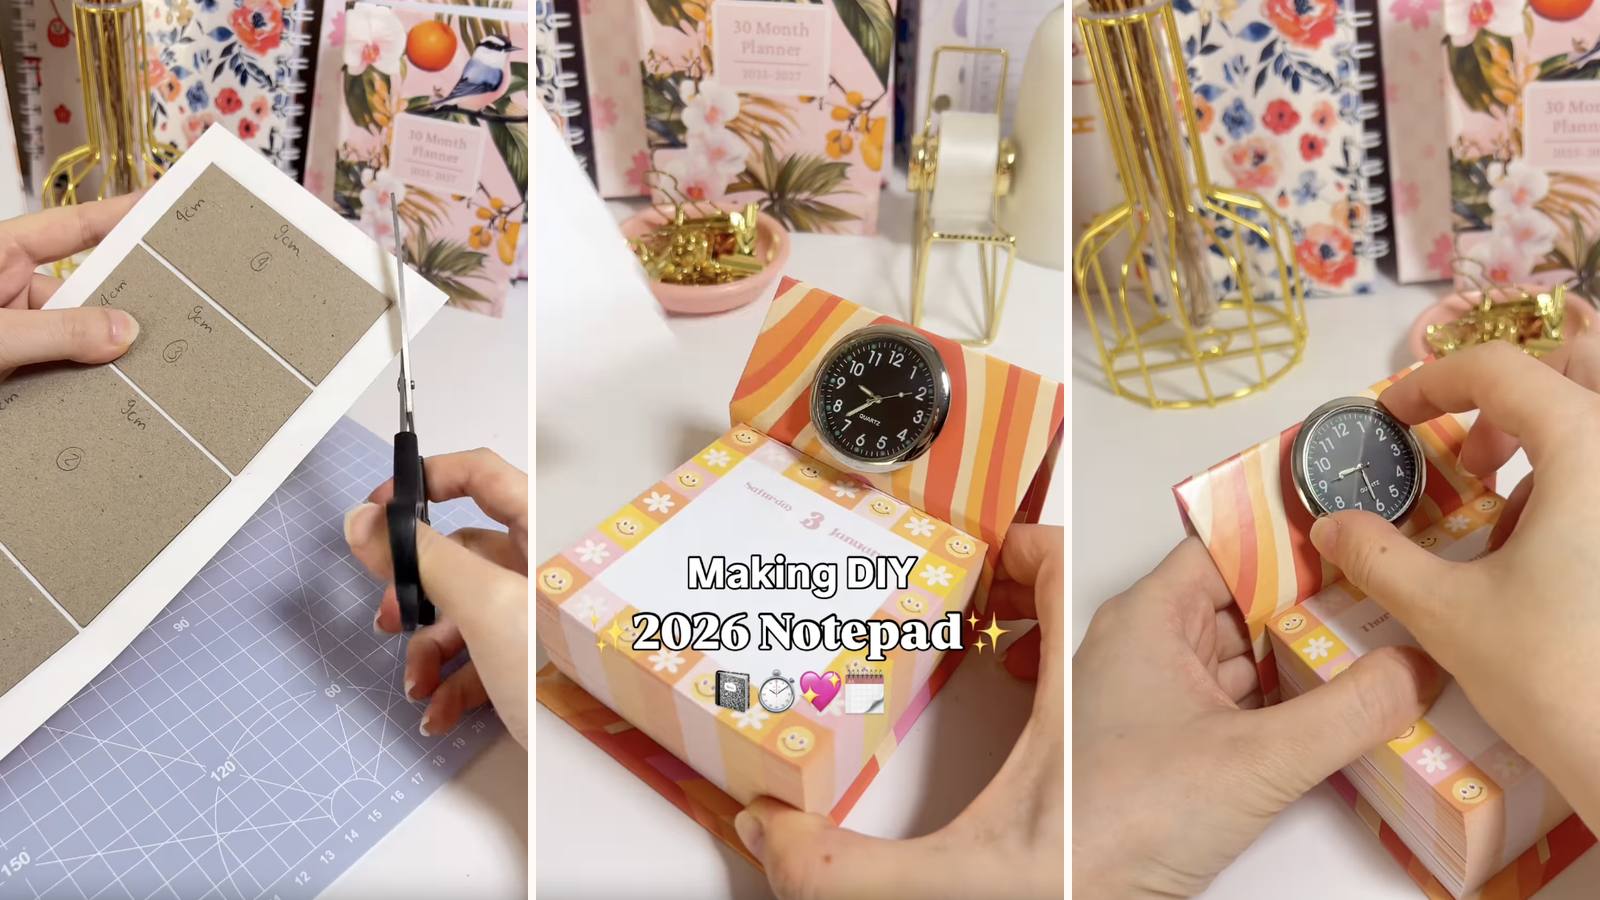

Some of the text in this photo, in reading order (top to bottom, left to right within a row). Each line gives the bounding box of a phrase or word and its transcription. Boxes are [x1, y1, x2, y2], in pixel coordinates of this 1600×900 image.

[733, 20, 809, 37] 30 Month
[741, 39, 802, 56] Planner
[1544, 100, 1565, 114] 30
[425, 131, 467, 150] Month
[412, 144, 459, 163] Planner
[176, 199, 205, 221] 4cm
[274, 224, 300, 257] 9cm
[100, 280, 127, 306] 4cm
[187, 305, 212, 333] 9cm
[868, 350, 882, 367] 11
[888, 350, 905, 368] 12
[849, 360, 865, 376] 10
[910, 366, 918, 380] 1
[836, 376, 846, 390] 9
[915, 386, 927, 401] 2
[833, 400, 843, 413] 8
[121, 399, 146, 430] 9cm
[859, 413, 881, 427] QUARTZ
[912, 410, 924, 424] 3
[841, 419, 852, 432] 7
[1332, 423, 1350, 438] 12
[1356, 421, 1365, 433] 1
[855, 434, 866, 447] 6
[897, 428, 908, 442] 4
[1375, 428, 1387, 442] 2
[876, 436, 888, 449] 5
[1319, 437, 1335, 453] 11
[1390, 444, 1401, 456] 3
[1314, 457, 1331, 473] 10
[1396, 465, 1405, 478] 4
[1318, 480, 1328, 493] 9
[1388, 484, 1399, 498] 5
[744, 481, 793, 512] Saturday
[800, 512, 825, 530] 3
[1335, 496, 1345, 509] 8
[1376, 499, 1385, 512] 6
[471, 720, 486, 734] 20
[452, 737, 466, 750] 19
[432, 755, 446, 768] 18
[411, 772, 425, 785] 17
[390, 790, 405, 803] 16
[367, 808, 383, 823] 15
[344, 829, 360, 844] 14
[320, 850, 336, 864] 13
[295, 871, 312, 886] 12
